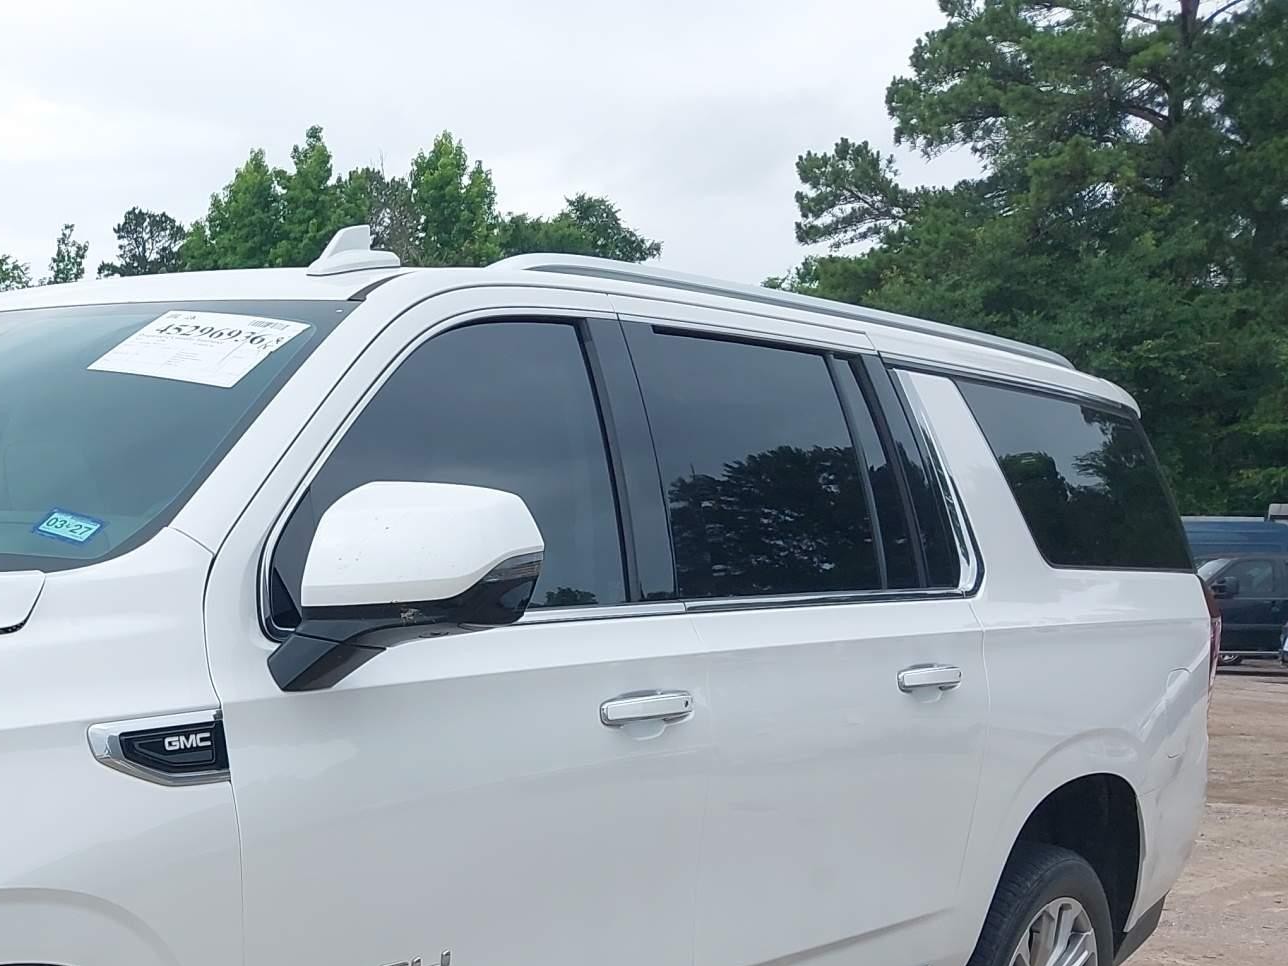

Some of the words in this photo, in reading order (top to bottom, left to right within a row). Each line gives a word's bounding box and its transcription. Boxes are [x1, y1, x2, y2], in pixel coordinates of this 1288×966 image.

[155, 323, 273, 345] 45296936
[46, 517, 68, 529] 03
[69, 523, 93, 535] 27
[164, 731, 212, 751] GMC
